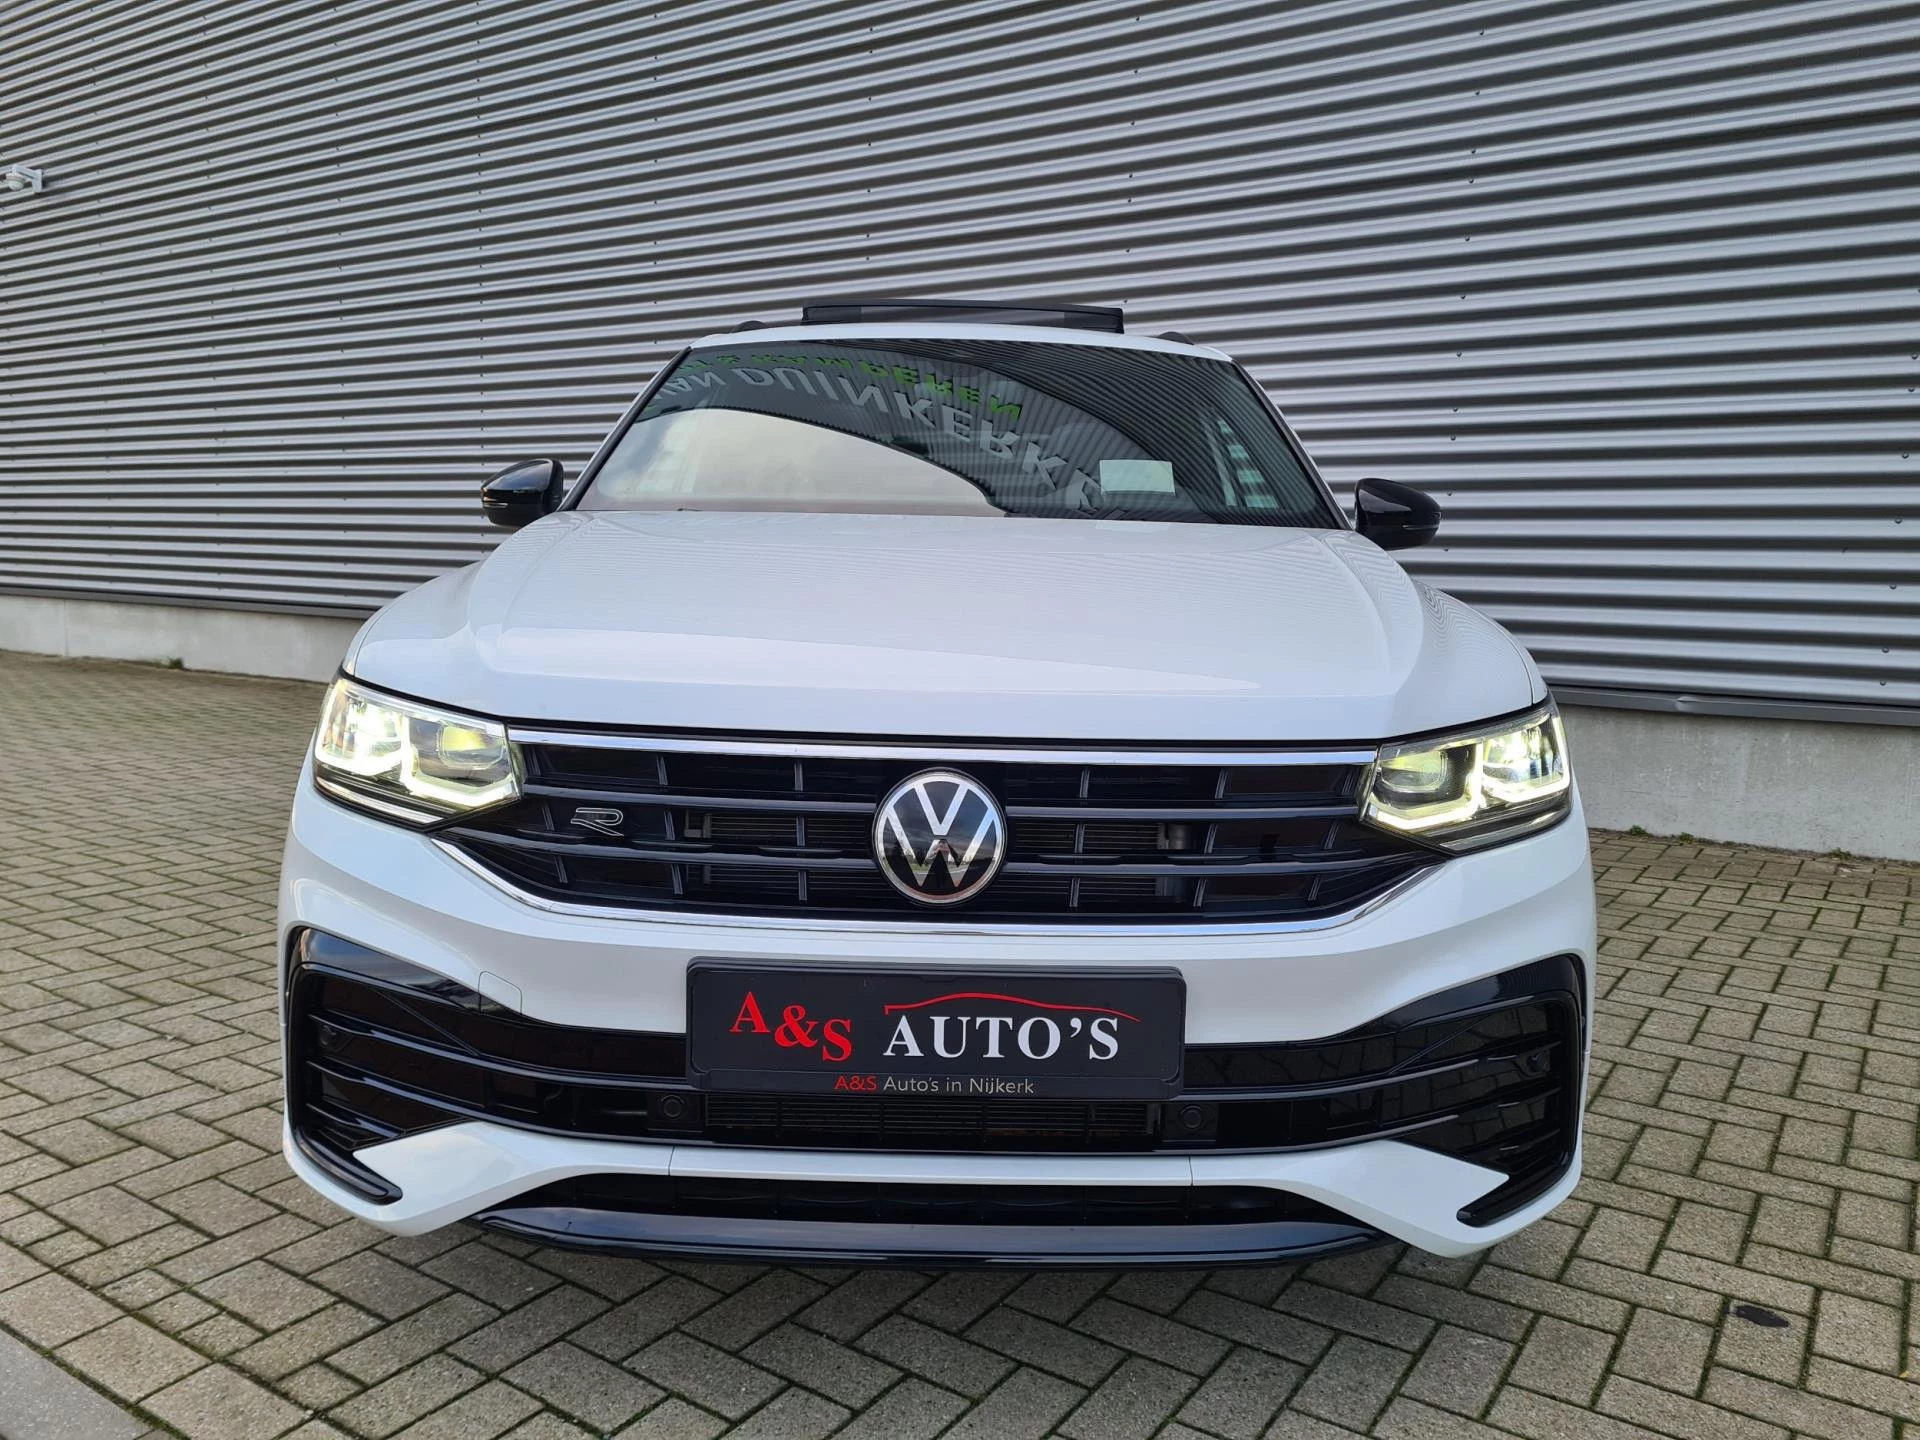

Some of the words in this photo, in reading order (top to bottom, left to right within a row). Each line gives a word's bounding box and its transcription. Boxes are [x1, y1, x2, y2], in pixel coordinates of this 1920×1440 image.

[570, 807, 625, 837] R
[882, 779, 998, 889] VW
[729, 990, 853, 1062] A&S
[882, 1014, 1119, 1061] AUTO'S
[834, 1075, 878, 1091] A&S
[883, 1075, 939, 1092] Auto's
[946, 1077, 962, 1092] in
[969, 1077, 1034, 1095] Nijkerk
